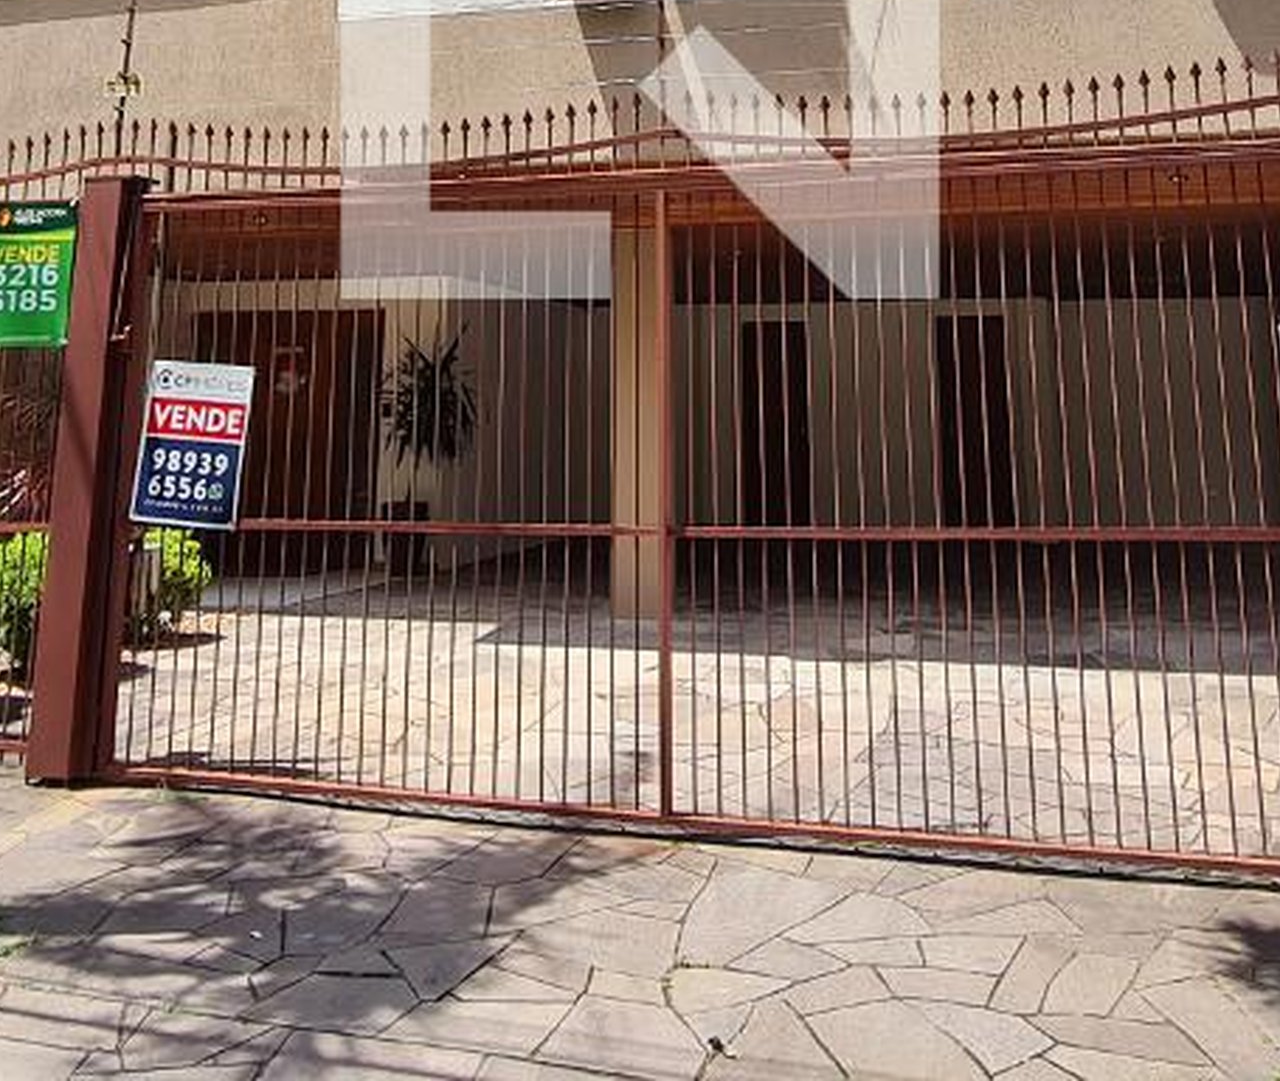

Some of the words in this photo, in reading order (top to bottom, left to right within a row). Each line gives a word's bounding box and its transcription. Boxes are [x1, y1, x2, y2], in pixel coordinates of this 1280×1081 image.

[154, 402, 243, 434] VENDE
[152, 448, 229, 476] 98939
[148, 474, 207, 501] 6556
